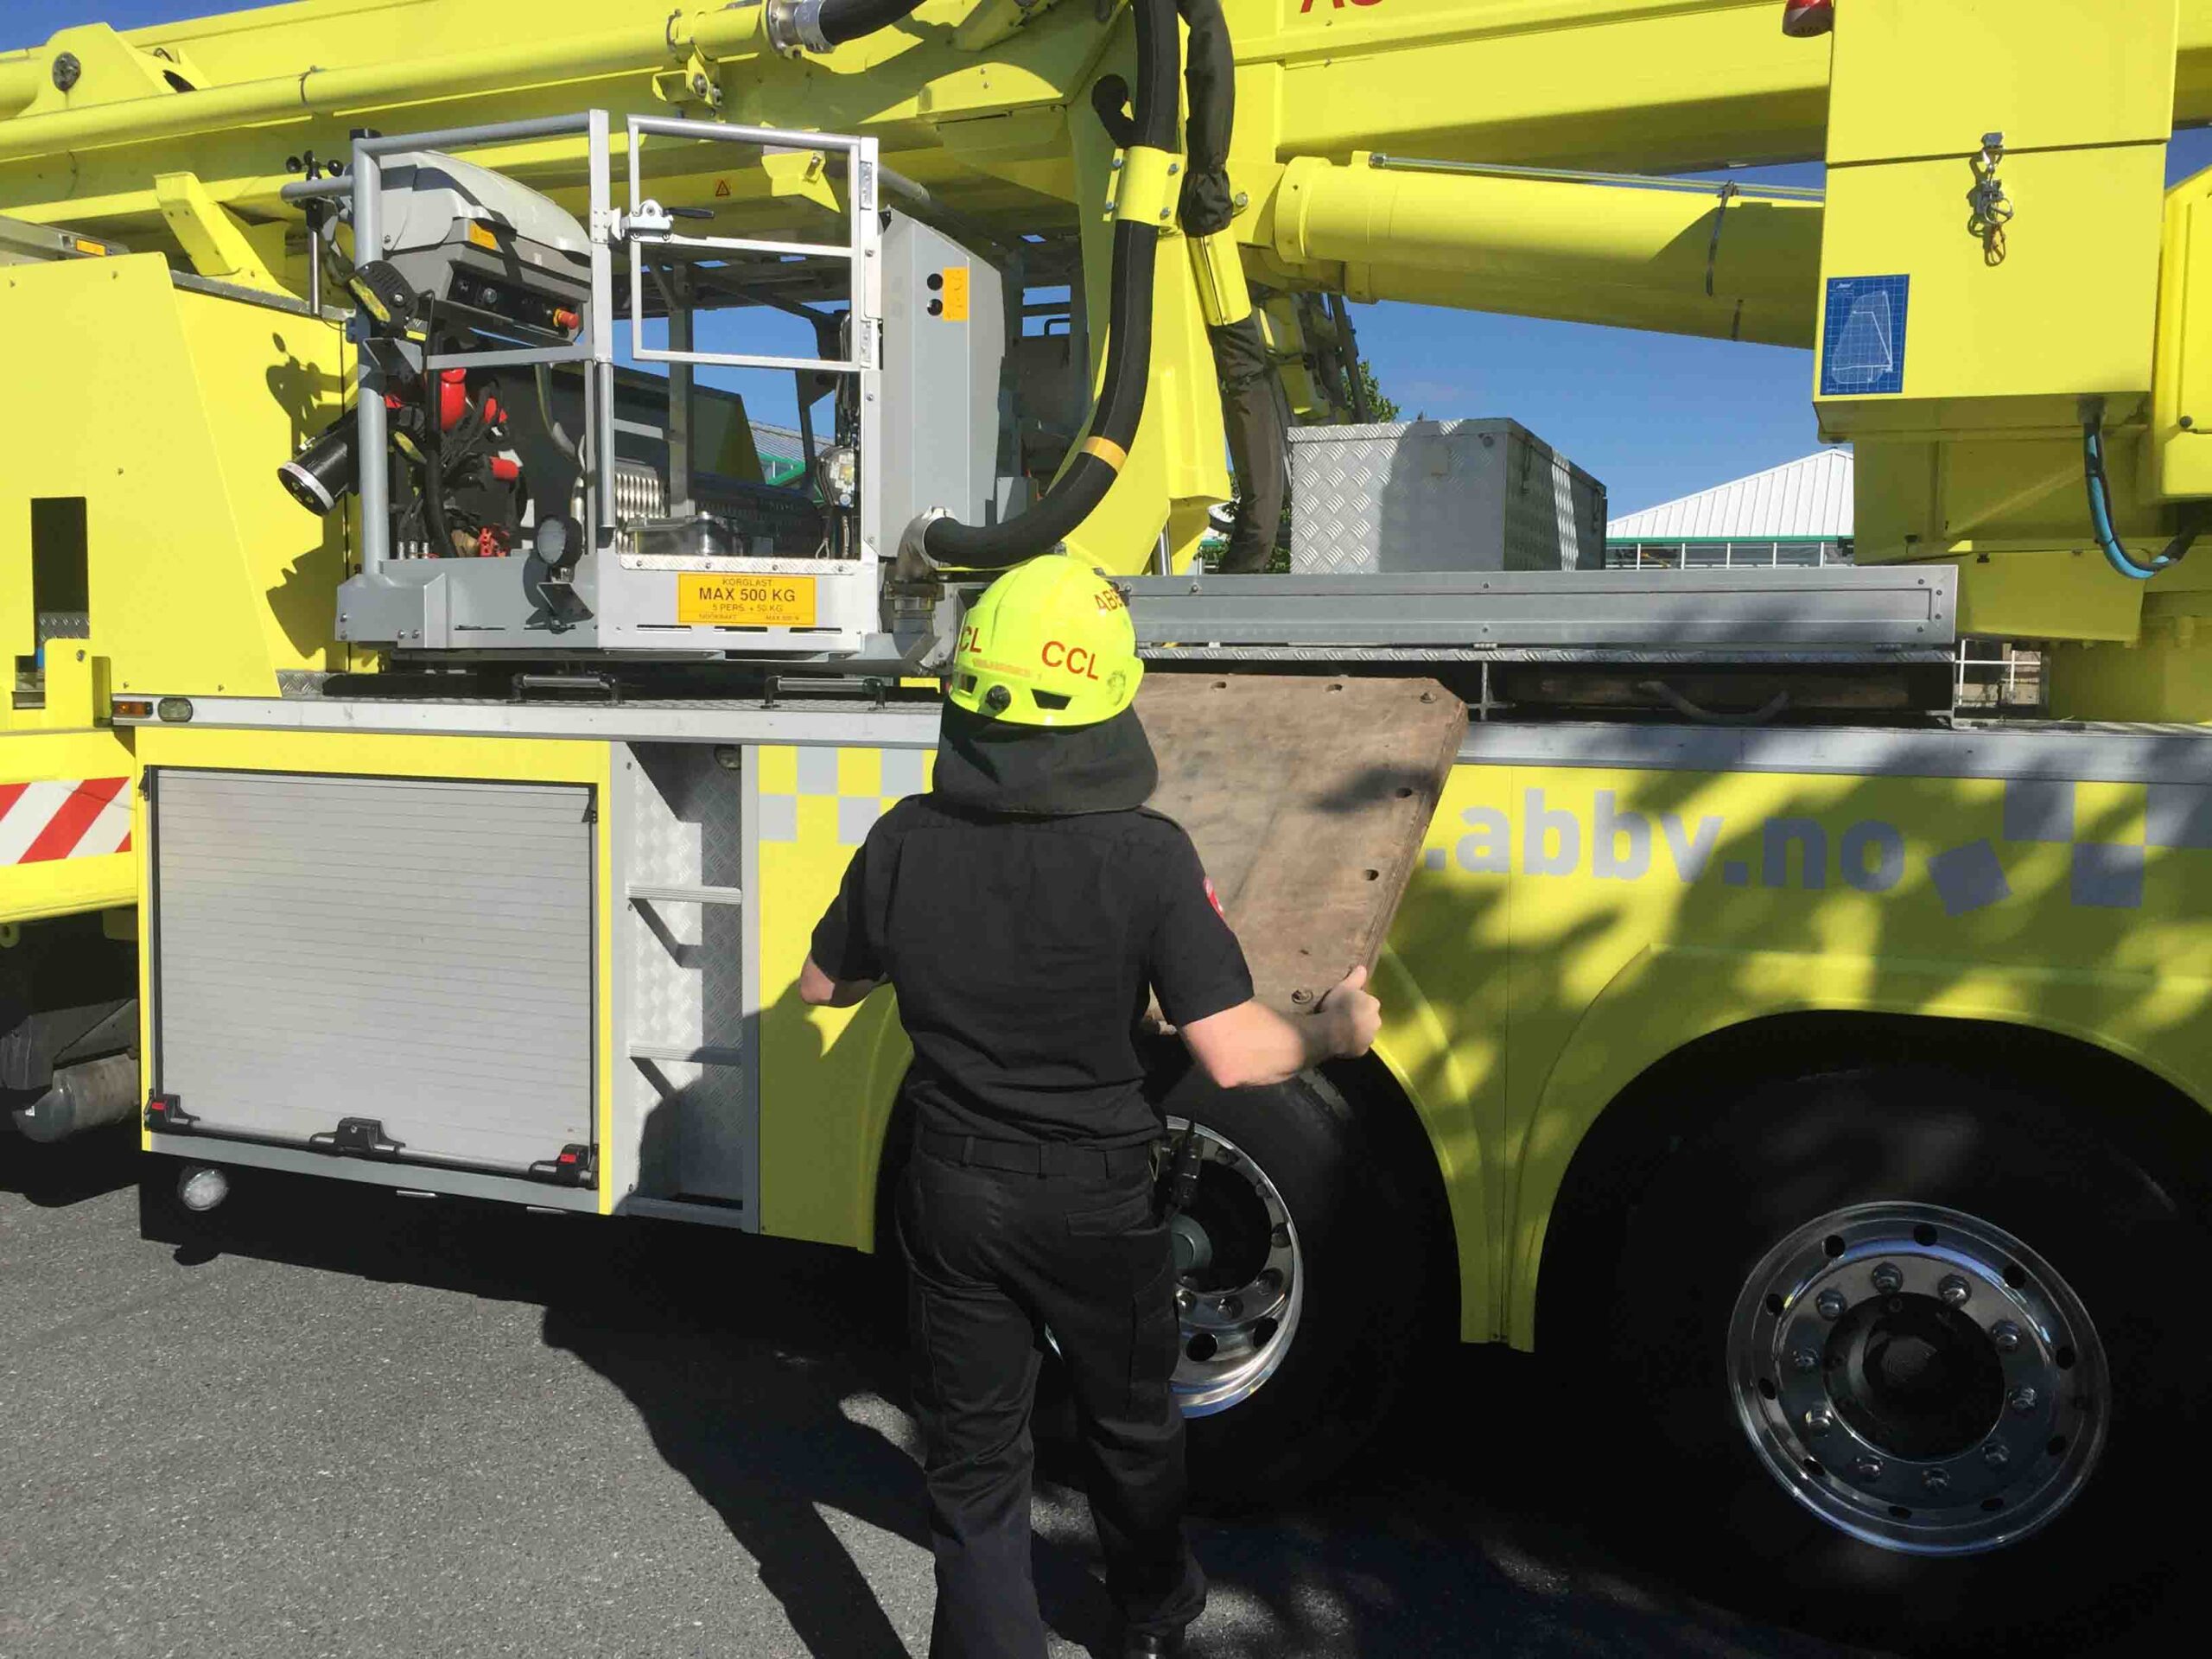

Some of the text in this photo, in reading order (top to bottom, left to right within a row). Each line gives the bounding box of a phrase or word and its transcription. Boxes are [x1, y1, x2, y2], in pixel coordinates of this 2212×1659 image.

[722, 577, 772, 587] KORGLAST
[699, 587, 796, 602] MAX 500 KG
[1041, 640, 1099, 680] CCL
